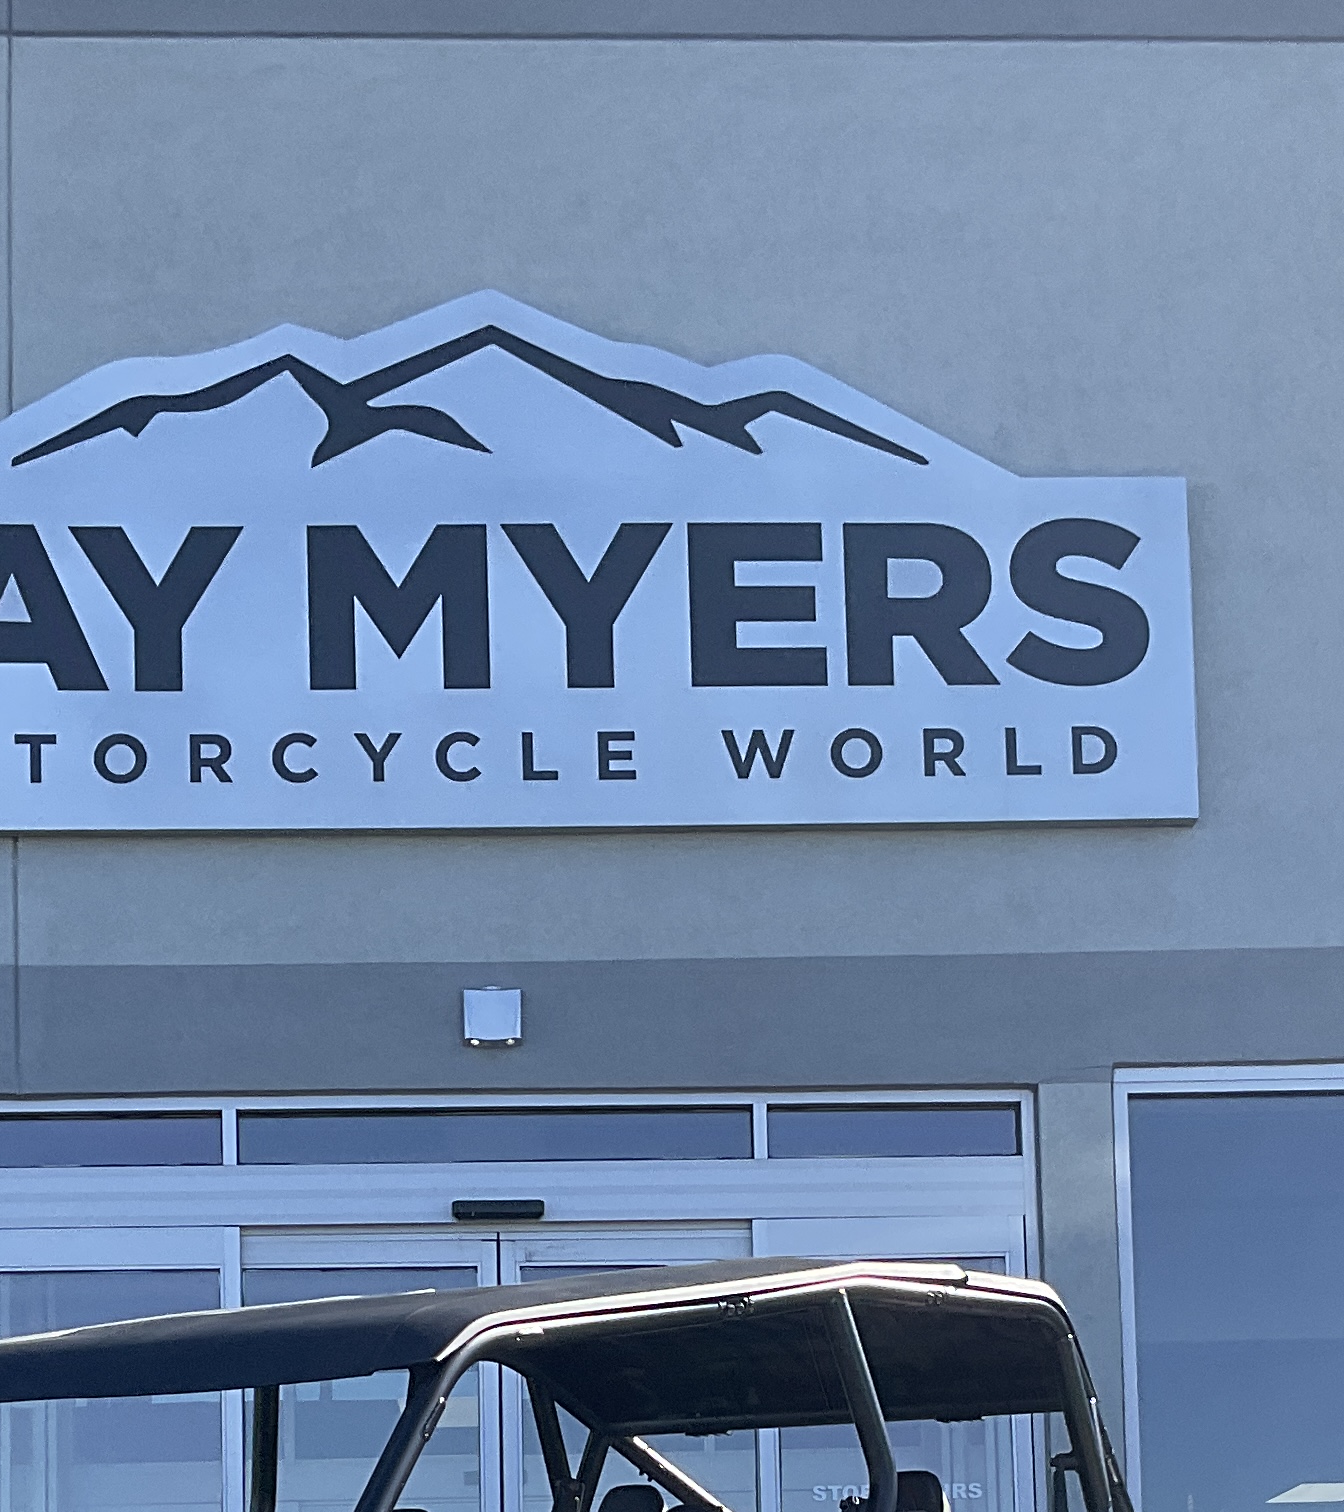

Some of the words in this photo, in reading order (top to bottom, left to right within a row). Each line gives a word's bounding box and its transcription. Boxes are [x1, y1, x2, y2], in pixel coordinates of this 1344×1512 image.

[306, 517, 1150, 691] MYERS
[720, 725, 1119, 780] WORLD
[812, 1484, 870, 1501] STO
